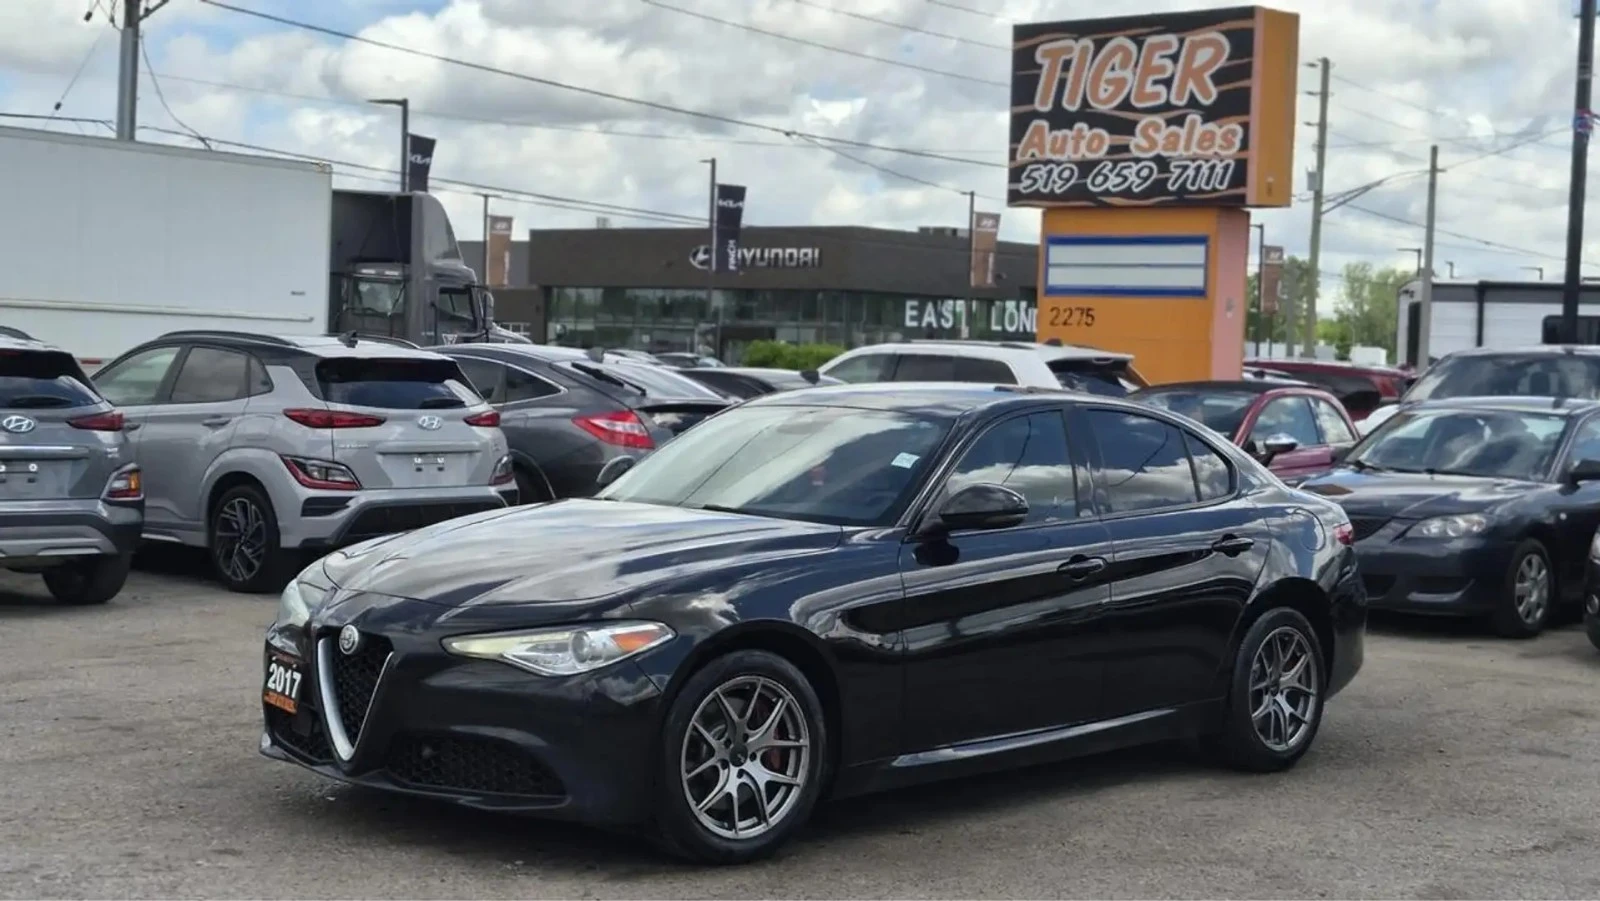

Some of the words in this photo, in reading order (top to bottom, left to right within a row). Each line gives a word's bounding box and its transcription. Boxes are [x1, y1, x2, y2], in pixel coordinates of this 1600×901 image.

[1034, 31, 1231, 111] TIGER
[1016, 119, 1110, 161] Auto
[1130, 114, 1243, 157] Sales
[1019, 163, 1079, 194] 519
[1086, 161, 1158, 192] 659
[1167, 159, 1235, 191] 7111
[1049, 306, 1095, 327] 2275
[267, 662, 302, 699] 2017
